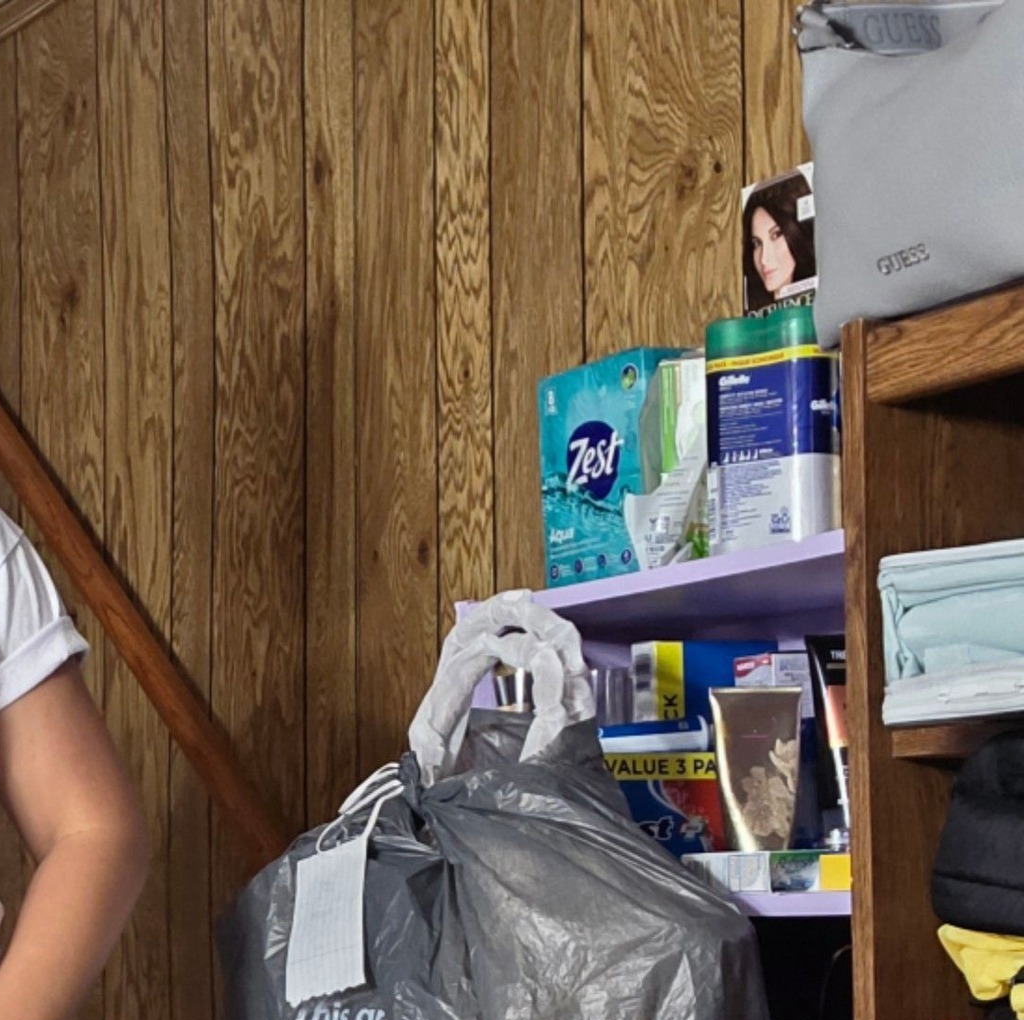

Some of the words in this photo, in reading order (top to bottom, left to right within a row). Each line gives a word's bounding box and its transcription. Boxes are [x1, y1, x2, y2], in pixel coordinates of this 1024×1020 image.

[864, 12, 943, 49] GUESS
[876, 243, 930, 276] GUESS
[566, 430, 624, 493] Zest
[605, 759, 669, 775] VALUE
[676, 759, 686, 774] 3
[693, 759, 718, 775] PA
